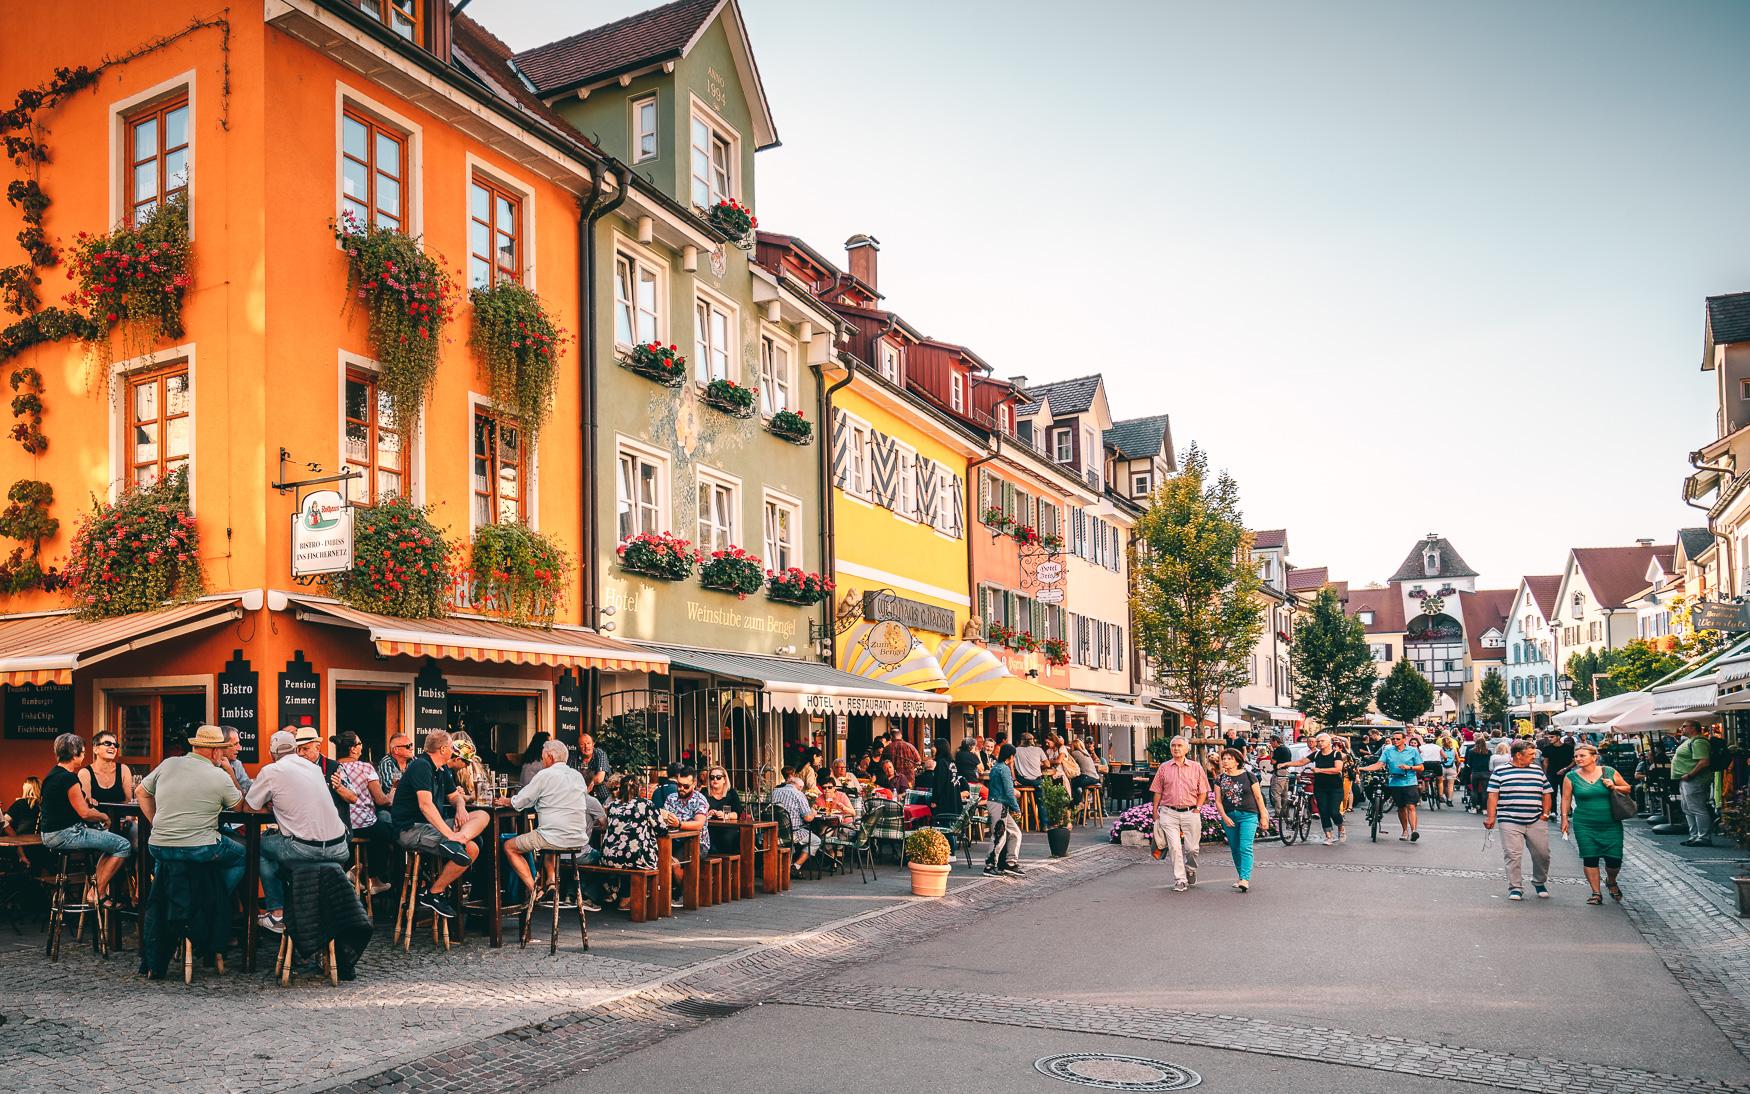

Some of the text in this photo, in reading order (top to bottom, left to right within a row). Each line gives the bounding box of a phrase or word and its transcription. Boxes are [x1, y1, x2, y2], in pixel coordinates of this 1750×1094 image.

[299, 540, 321, 550] BISTRO
[324, 538, 345, 547] IMBISS
[307, 548, 348, 560] FISCHERNETZ
[687, 601, 796, 640] Weinstube zum Bengel
[870, 641, 891, 649] Zum
[879, 648, 906, 657] Bengel
[222, 683, 253, 695] Bistro
[285, 679, 316, 689] Pension
[418, 686, 446, 699] Imbiss
[285, 695, 316, 705] Zimmer
[561, 695, 572, 703] Fisch
[807, 695, 927, 713] HOTEL RESTAURANT BENGEL
[221, 706, 254, 718] Imbiss
[421, 706, 443, 715] Pommes
